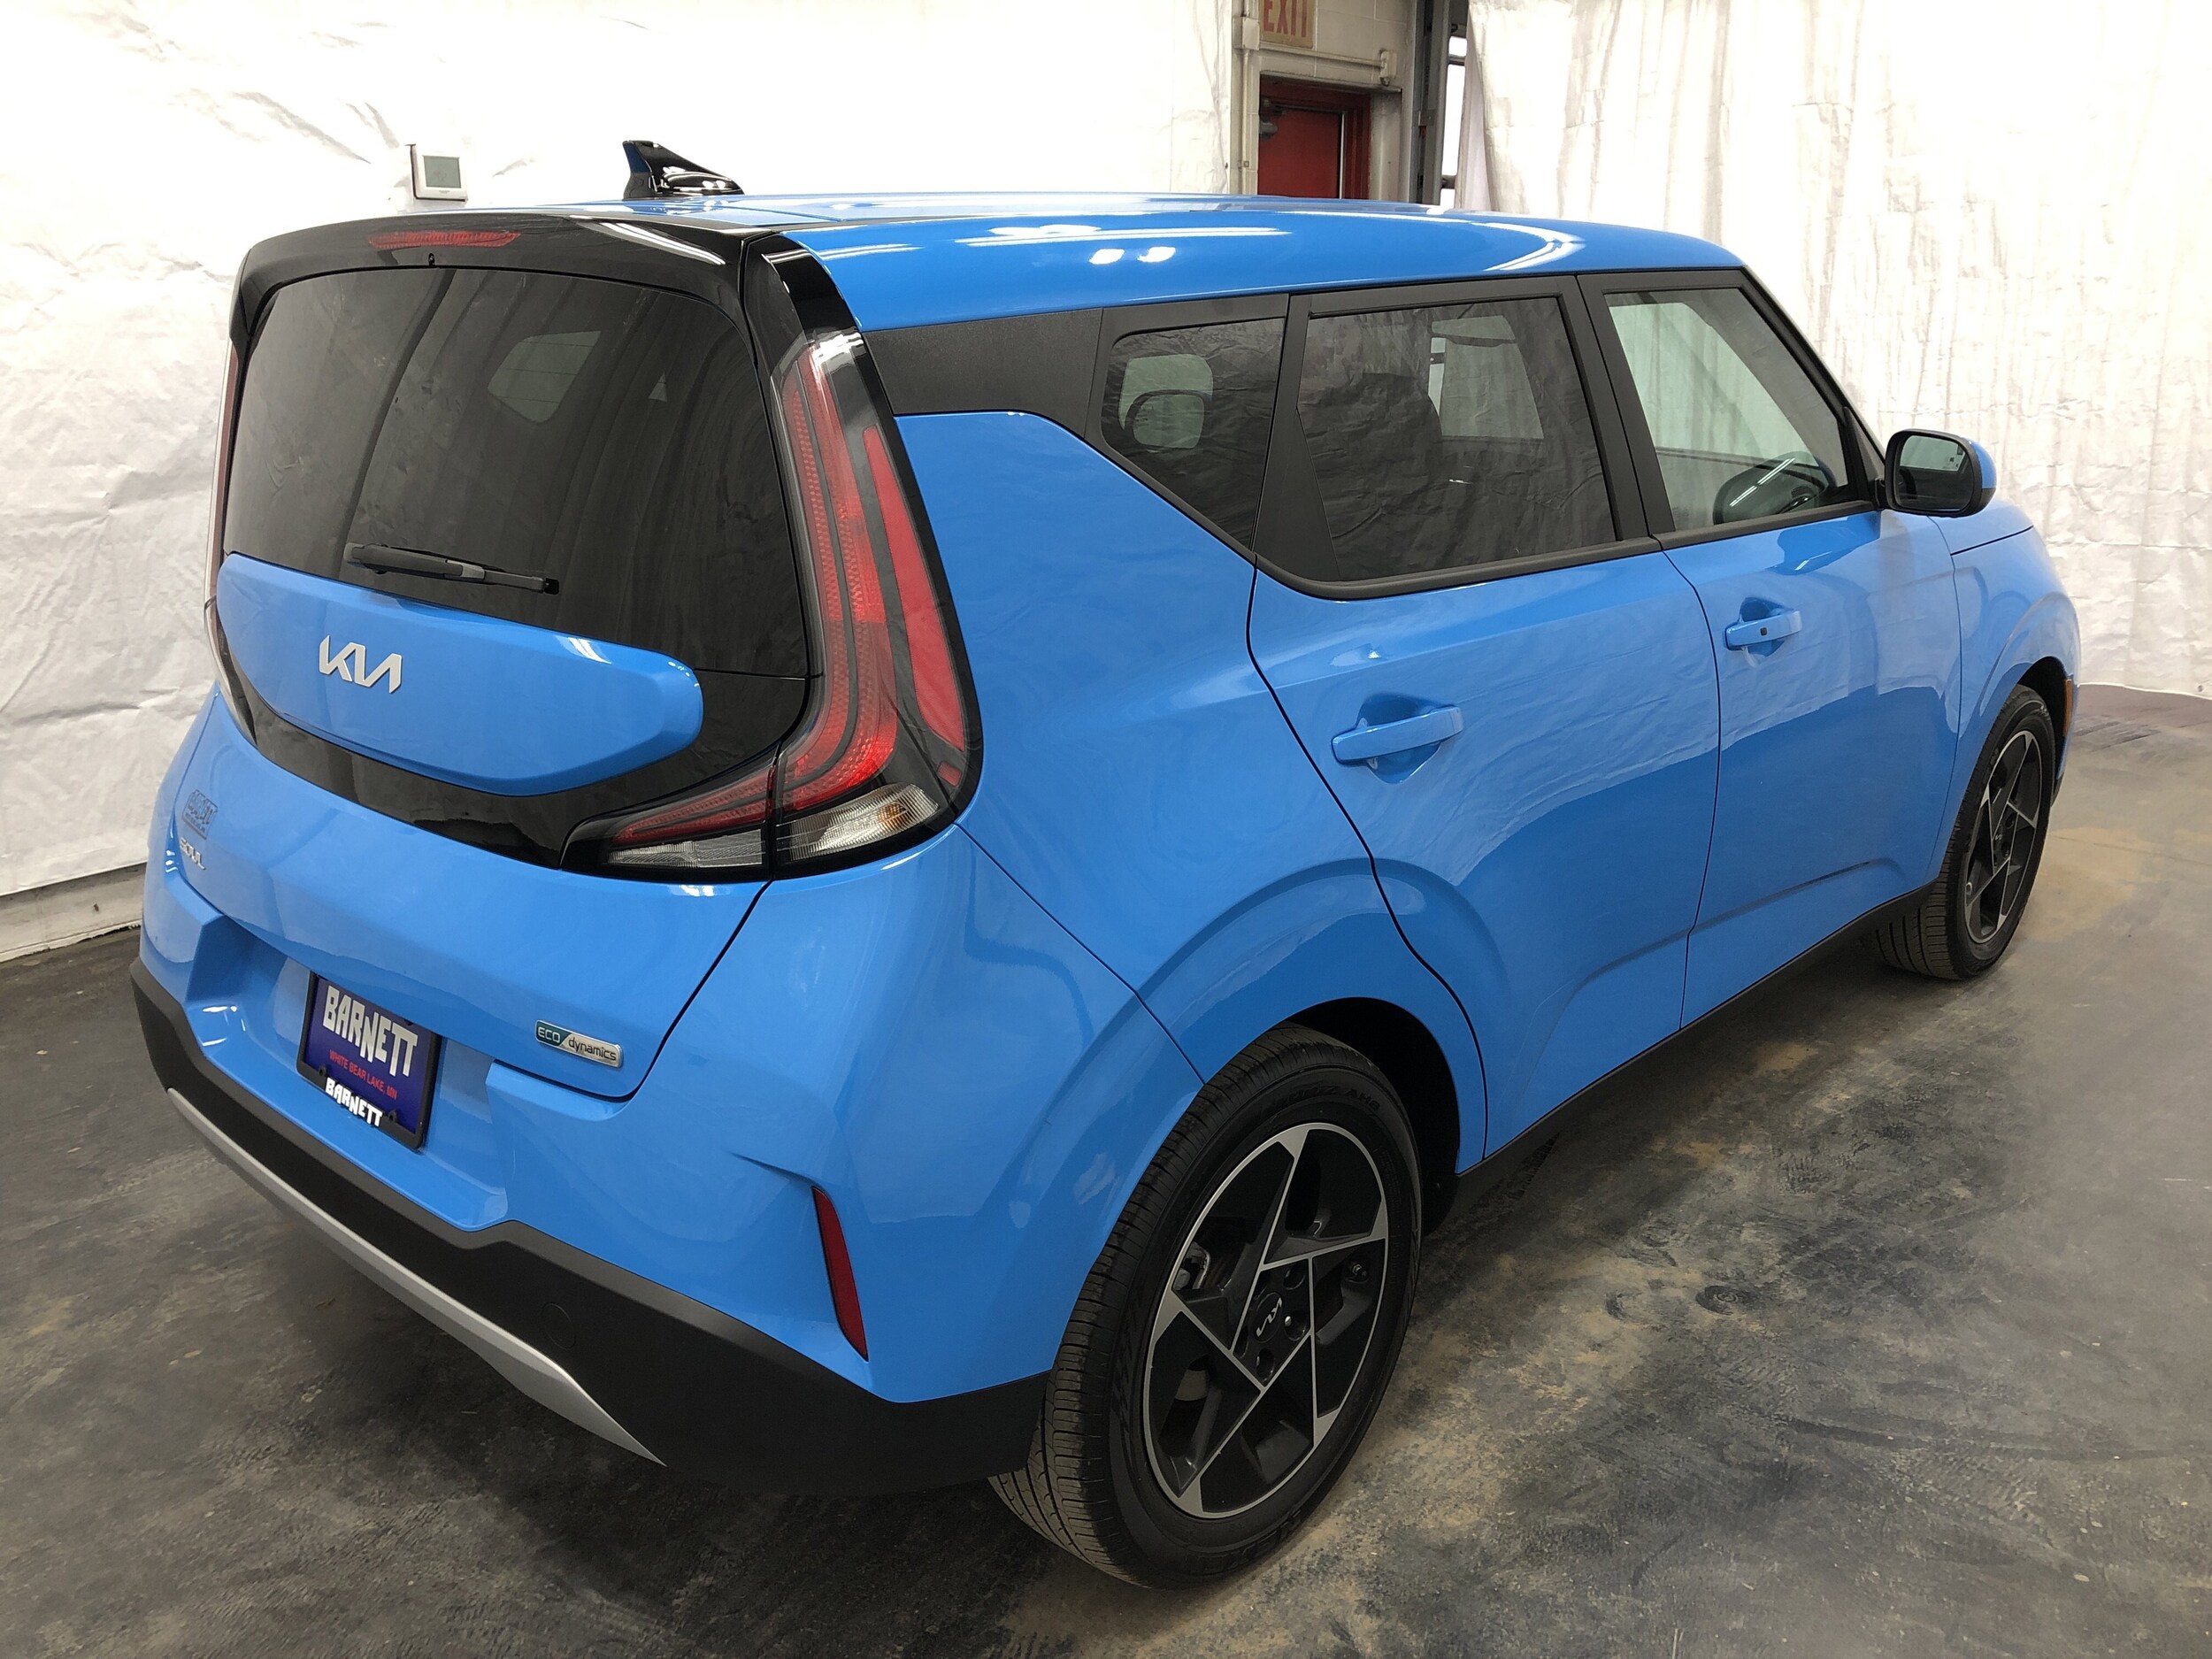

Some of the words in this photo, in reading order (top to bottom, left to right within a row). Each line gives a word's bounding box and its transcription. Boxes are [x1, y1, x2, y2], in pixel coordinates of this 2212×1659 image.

[319, 634, 403, 694] KIA
[323, 985, 418, 1077] BARNETT
[538, 1026, 561, 1043] ECO
[568, 1036, 617, 1061] dynamics
[329, 1049, 349, 1070] WHITE
[349, 1062, 367, 1080] BEAR
[367, 1073, 385, 1094] LAKE,
[326, 1077, 383, 1126] BARNETT
